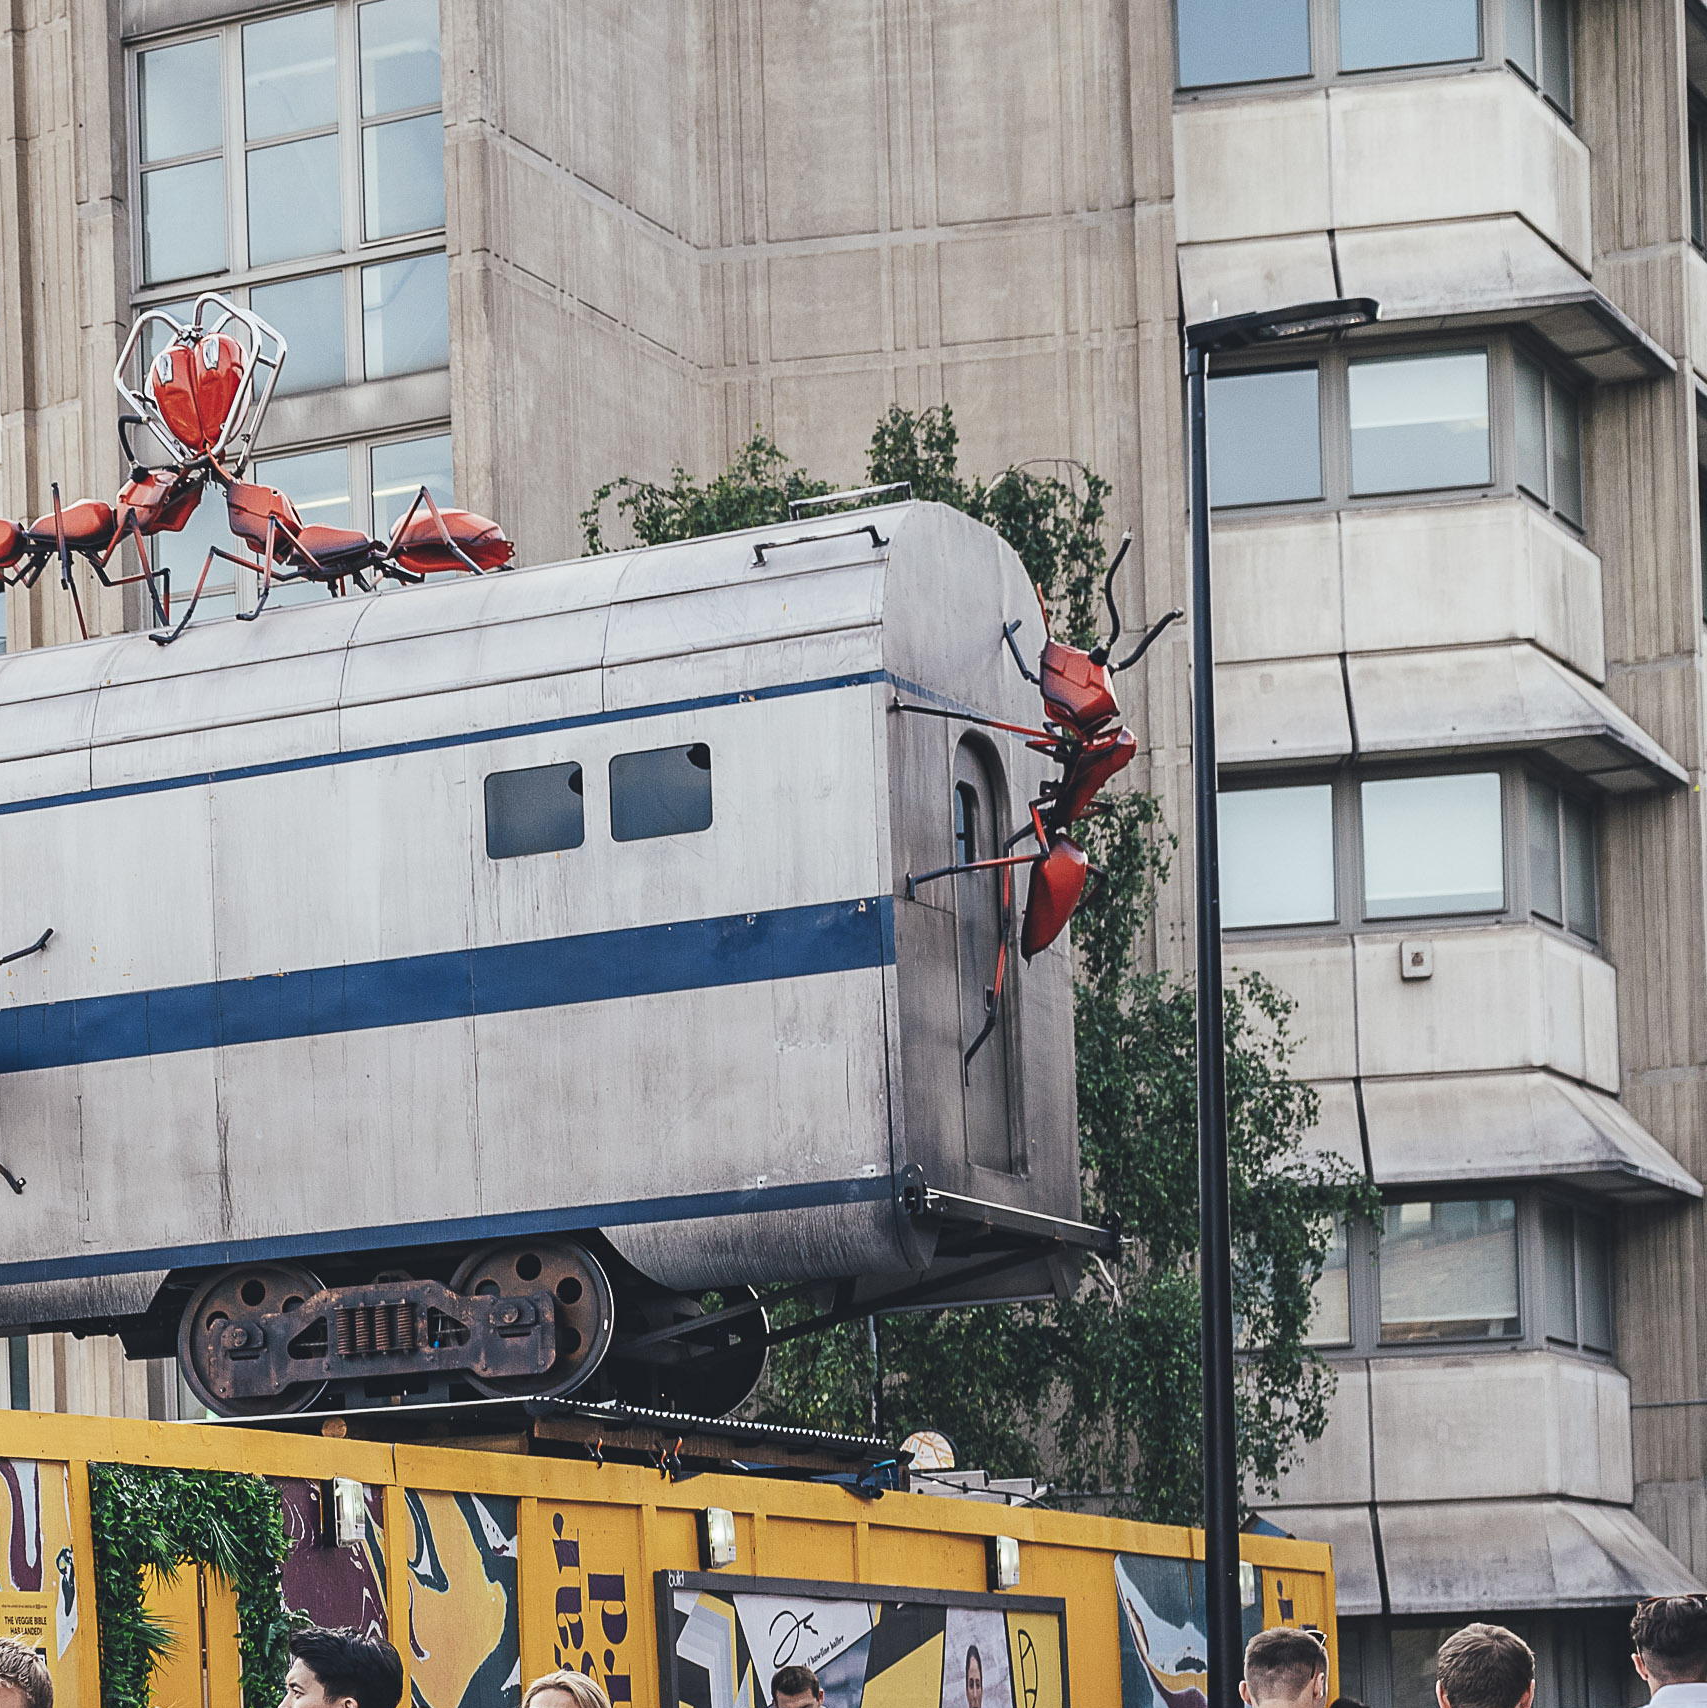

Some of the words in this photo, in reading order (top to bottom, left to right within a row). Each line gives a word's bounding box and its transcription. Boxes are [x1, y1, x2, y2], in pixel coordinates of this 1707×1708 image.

[668, 1571, 685, 1588] build
[4, 1616, 14, 1625] THE
[15, 1616, 33, 1625] VEGGIE
[34, 1616, 47, 1626] BIBLE
[10, 1627, 20, 1635] HAS
